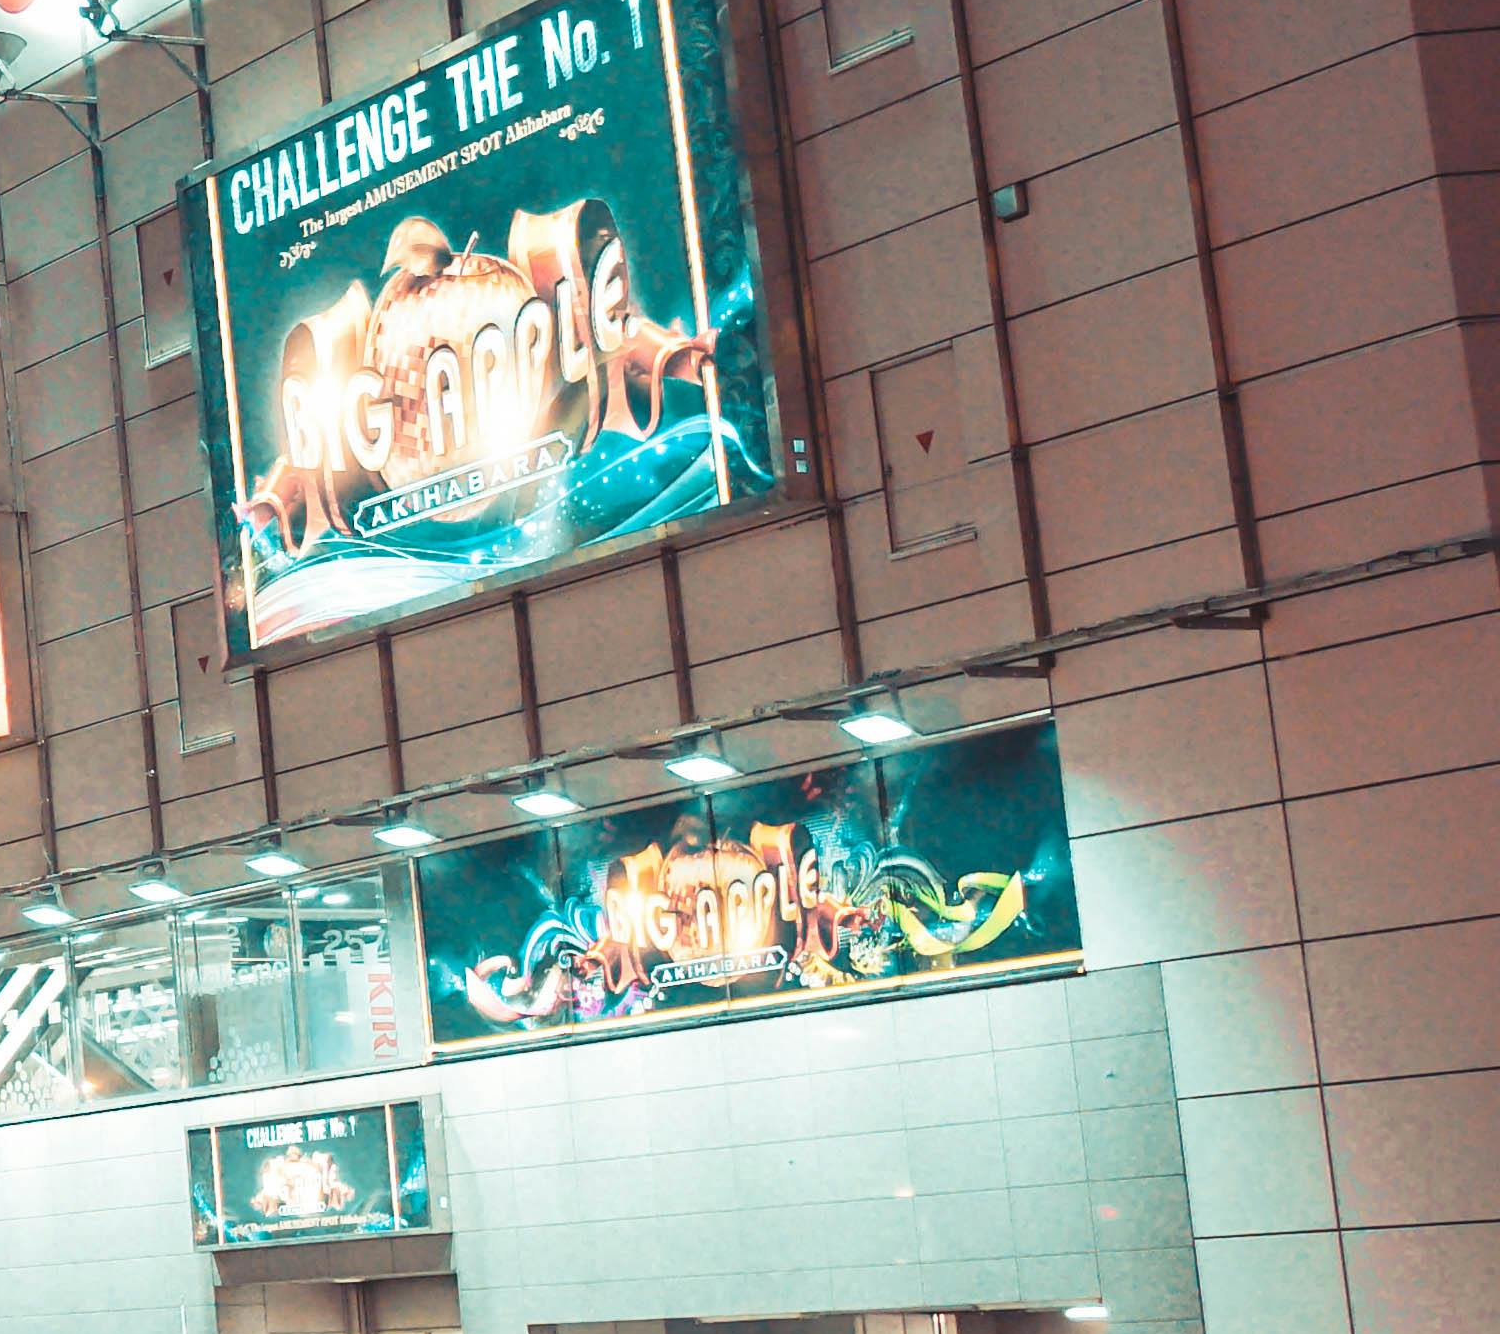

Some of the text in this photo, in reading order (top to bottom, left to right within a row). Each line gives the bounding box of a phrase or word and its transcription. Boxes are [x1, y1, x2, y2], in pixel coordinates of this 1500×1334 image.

[230, 80, 434, 235] CHALLENGE
[446, 34, 523, 132] THE
[541, 9, 610, 90] No.
[299, 103, 572, 238] The largest AMUSEMENT SPOT Akihabara
[282, 369, 394, 473] BIG
[367, 446, 557, 530] AKIHABARA
[661, 956, 779, 983] AKIHABARA
[246, 1122, 304, 1149] CHALLENGE
[305, 1120, 327, 1142] THE
[330, 1117, 348, 1139] No.
